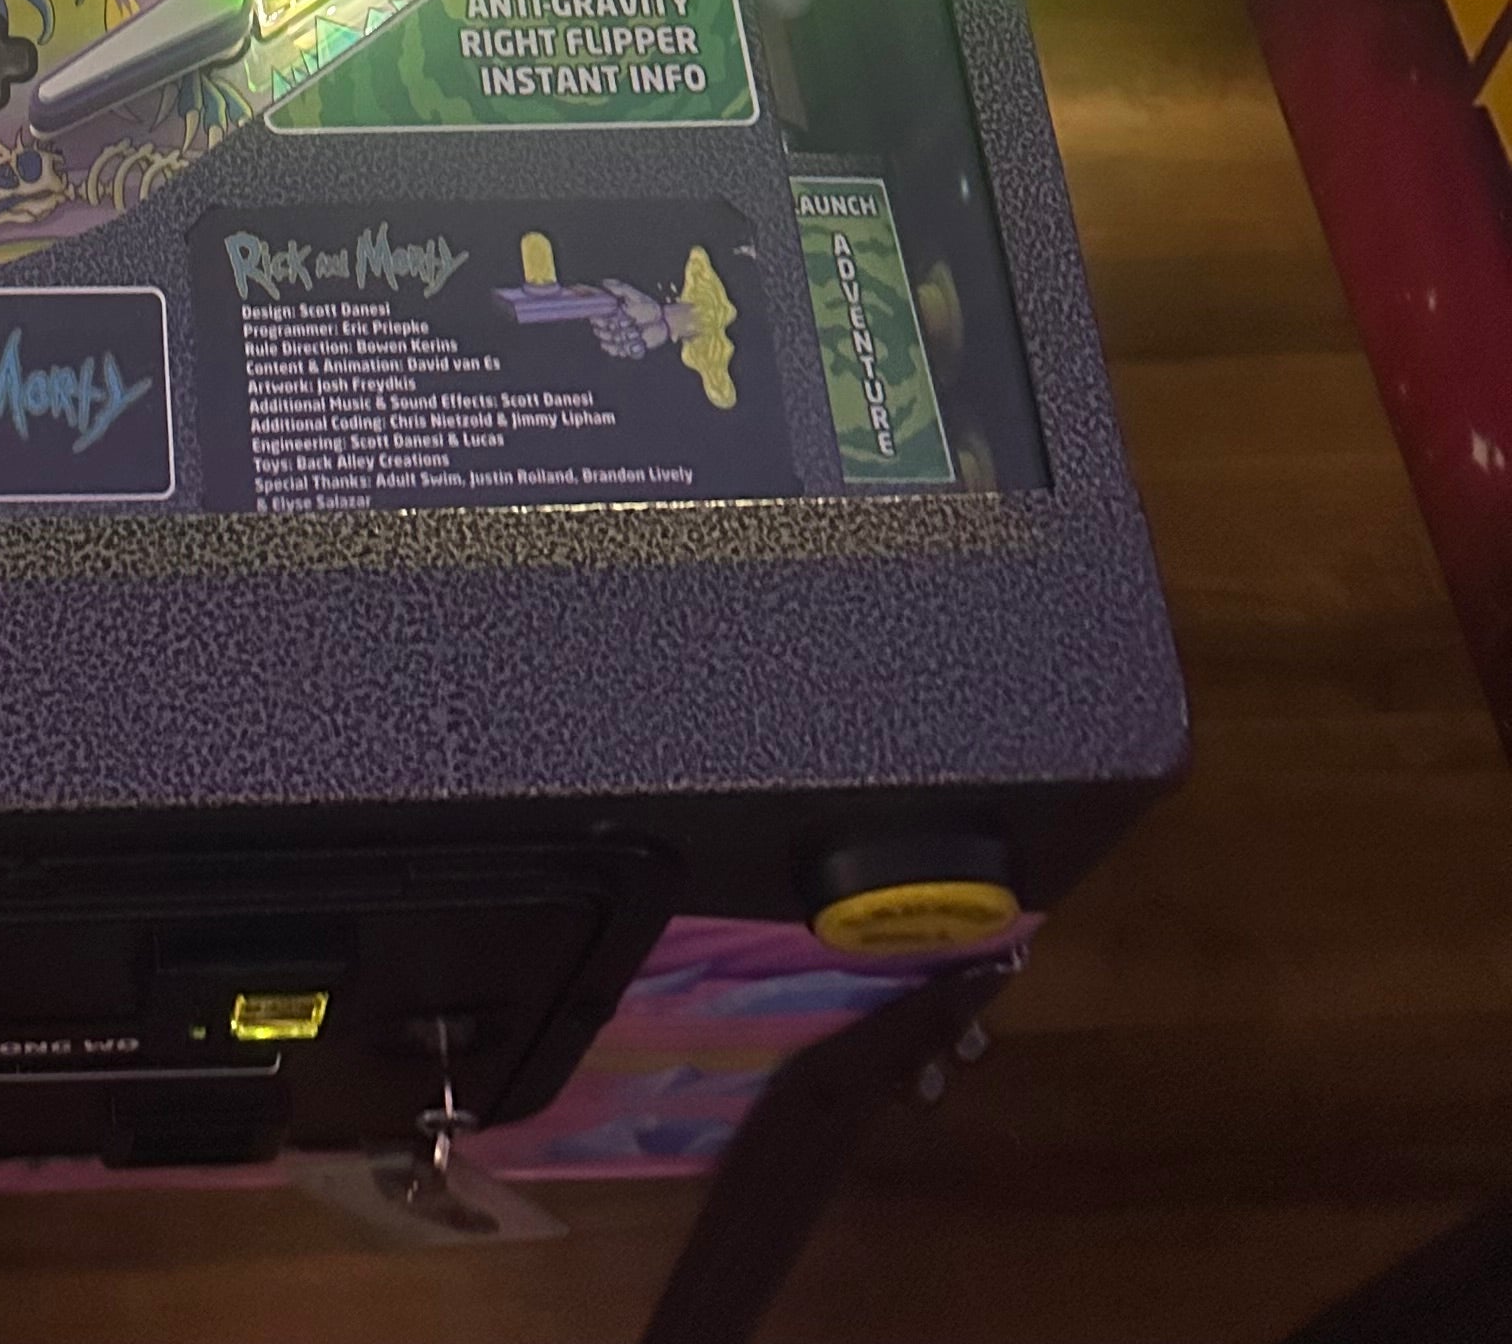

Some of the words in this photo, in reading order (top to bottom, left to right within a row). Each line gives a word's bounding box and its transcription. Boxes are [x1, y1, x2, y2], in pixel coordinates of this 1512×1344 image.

[460, 28, 558, 58] RIGHT
[566, 26, 699, 56] FLIPPER
[480, 65, 620, 96] INSTANT
[629, 63, 707, 93] INFO
[795, 195, 877, 217] AUNCH
[833, 232, 896, 458] ADVENTURE
